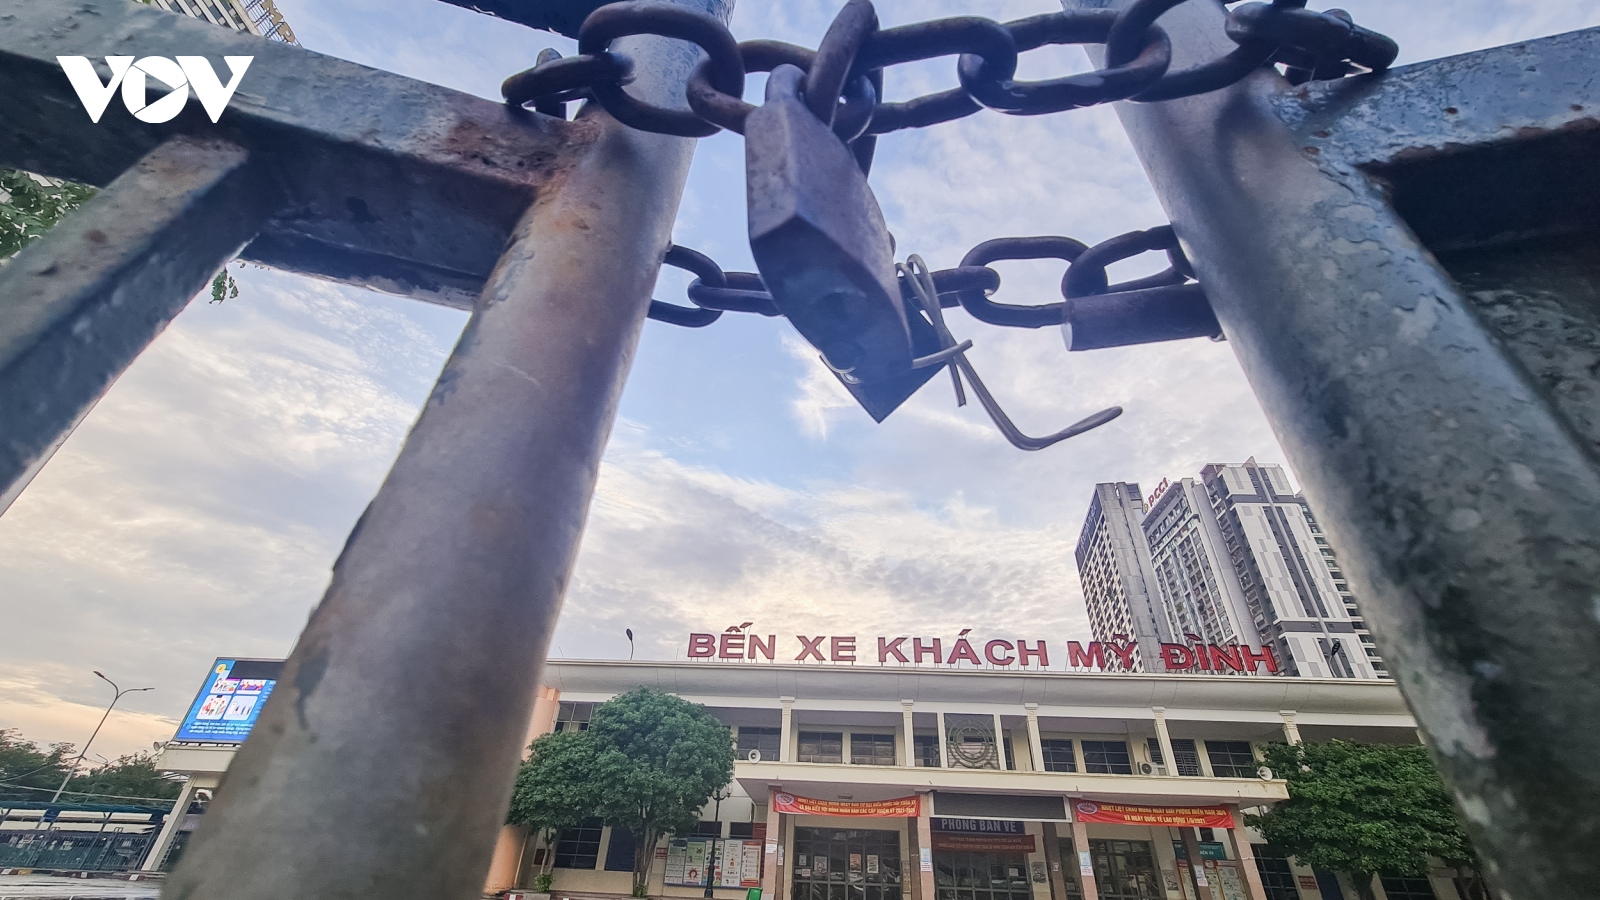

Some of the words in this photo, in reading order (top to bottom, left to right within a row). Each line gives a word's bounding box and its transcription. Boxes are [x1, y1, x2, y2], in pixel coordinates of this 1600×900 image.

[687, 622, 776, 660] BẾN
[794, 635, 856, 662] XE
[878, 628, 1049, 667] KHÁCH
[1066, 633, 1139, 669] MỸ
[1159, 633, 1279, 672] ĐÌNH
